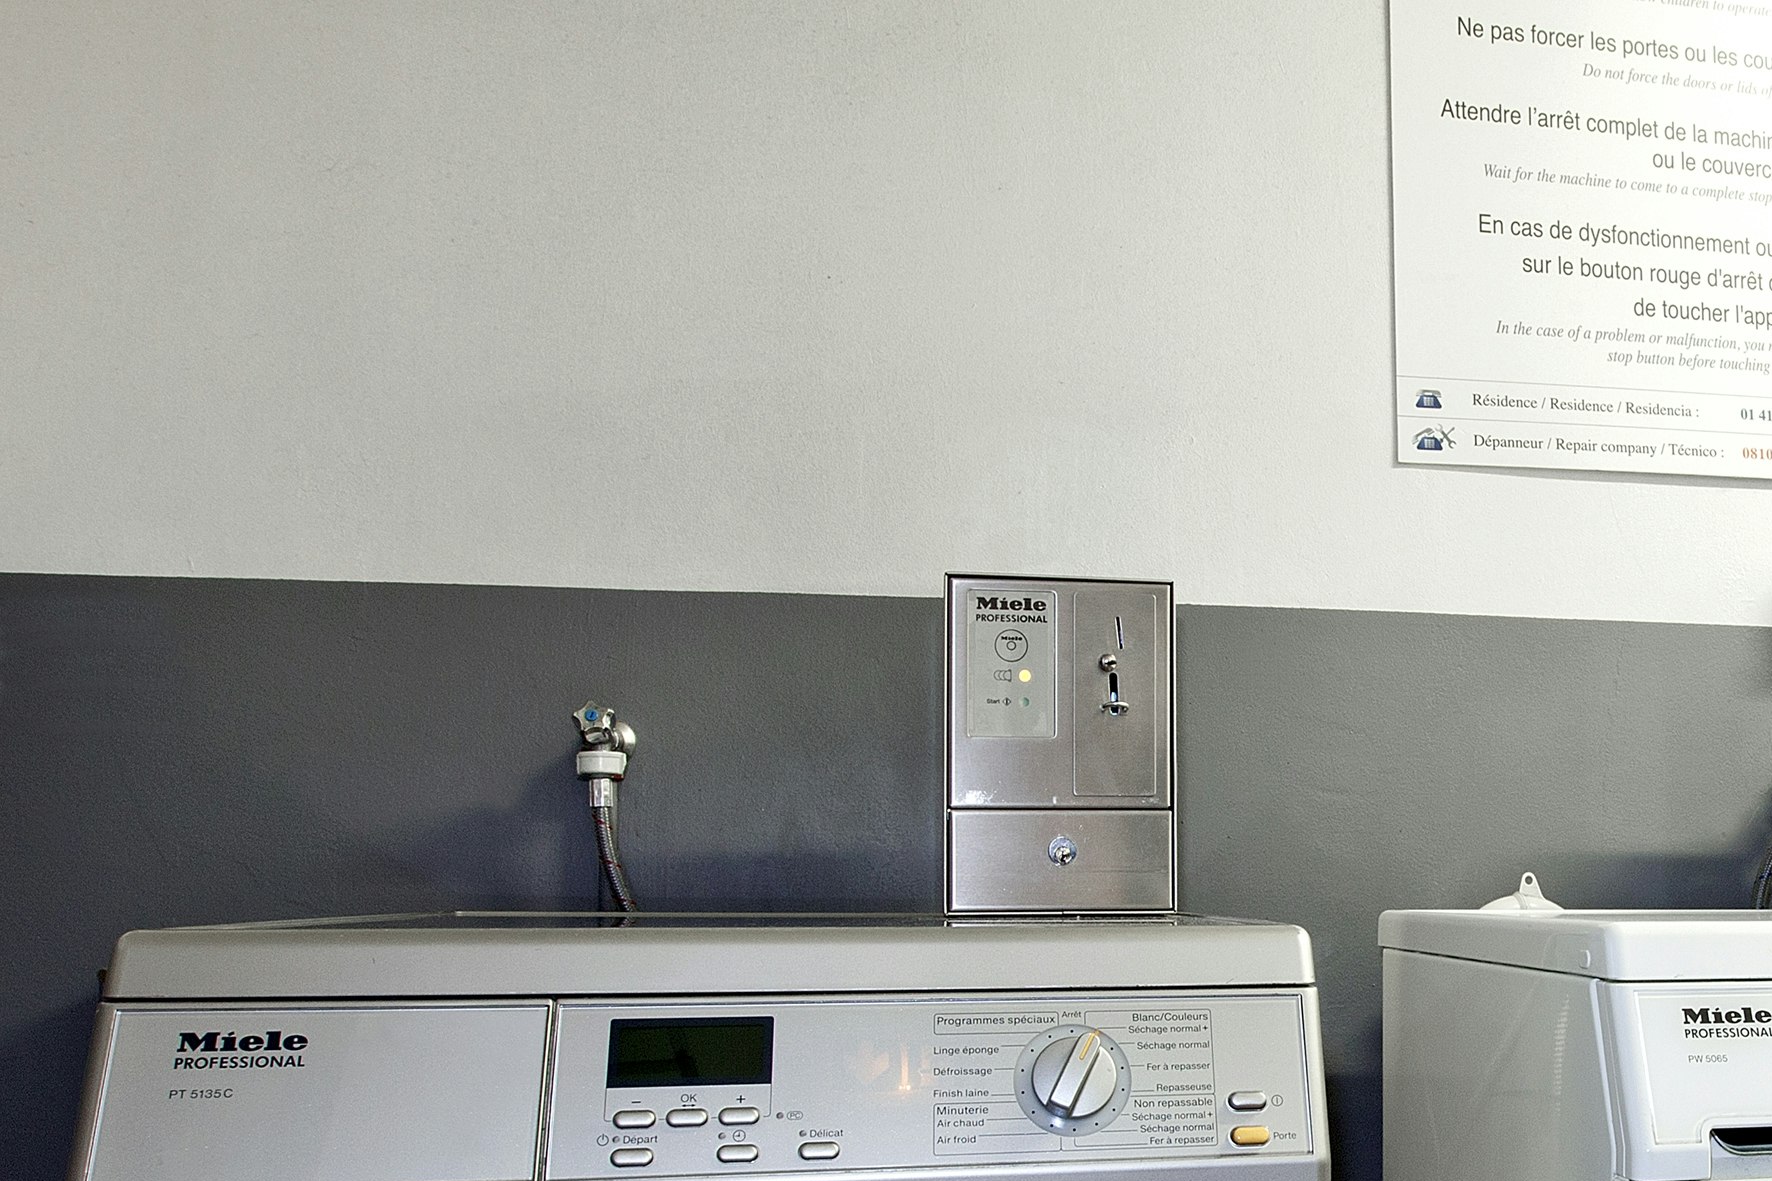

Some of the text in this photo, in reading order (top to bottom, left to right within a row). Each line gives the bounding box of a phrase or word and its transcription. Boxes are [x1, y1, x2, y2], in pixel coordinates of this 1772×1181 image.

[1457, 16, 1484, 38] Ne
[1491, 24, 1525, 44] pas
[1531, 25, 1584, 49] forcer
[1590, 31, 1616, 52] les
[1623, 38, 1679, 59] portes
[1685, 46, 1706, 63] ou
[1713, 46, 1738, 66] les
[1582, 63, 1717, 91] Do not force the doors
[1440, 98, 1521, 125] Attendre
[1586, 118, 1658, 140] complet
[1664, 121, 1686, 141] de
[1693, 124, 1708, 144] la
[1652, 153, 1674, 169] ou
[1681, 151, 1696, 171] le
[1484, 163, 1512, 179] Wait
[1512, 167, 1533, 183] for
[1537, 168, 1556, 183] the
[1559, 172, 1611, 189] machine
[1631, 180, 1662, 193] come
[1692, 185, 1745, 201] complete
[1748, 191, 1772, 206] stop
[1478, 213, 1504, 235] En
[1510, 219, 1543, 238] cas
[1549, 220, 1572, 240] de
[1579, 222, 1750, 255] dysfonctionnement
[1522, 257, 1552, 274] sur
[1557, 256, 1574, 276] le
[1580, 257, 1643, 281] bouton
[1650, 267, 1701, 290] rouge
[1707, 269, 1763, 291] d'arrêt
[1633, 298, 1730, 323] de toucher
[1496, 320, 1510, 335] In
[1513, 321, 1532, 336] the
[1536, 326, 1564, 338] case
[1567, 325, 1583, 342] of
[1594, 328, 1645, 344] problem
[1666, 333, 1741, 351] malfunction,
[1743, 340, 1765, 354] you
[1607, 351, 1633, 367] stop
[1636, 350, 1675, 367] button
[1678, 355, 1716, 371] before
[1719, 357, 1770, 375] touching
[1472, 394, 1614, 414] Résidence Residence
[1740, 407, 1755, 420] 01
[1759, 409, 1772, 422] 41
[1473, 434, 1717, 458] Dépanneur Repair company Técnico
[1742, 447, 1772, 461] 0810
[976, 597, 1047, 612] Miele
[976, 614, 1048, 623] PROFESSIONAL
[1061, 1010, 1082, 1019] Arrêt
[1132, 1012, 1208, 1022] Blanc/Couleurs
[1681, 1007, 1772, 1024] Miele
[936, 1015, 1056, 1027] Programmes spéciaux
[1128, 1025, 1168, 1035] Séchage
[176, 1030, 308, 1053] Miele
[1136, 1040, 1210, 1051] Séchage normal
[933, 1045, 999, 1056] Linge éponge
[173, 1055, 305, 1070] PROFESSIONAL
[1705, 1054, 1728, 1063] 5065
[933, 1066, 992, 1077] Défroissage
[1170, 1063, 1211, 1072] repasser
[933, 1088, 989, 1098] Finish laine
[1156, 1083, 1212, 1093] Repasseuse
[1134, 1098, 1213, 1109] Non repassable
[936, 1105, 989, 1116] Minuterie
[953, 1118, 985, 1127] chaud
[1131, 1112, 1172, 1122] Séchage
[809, 1128, 844, 1138] Délicat
[1140, 1123, 1214, 1134] Séchage normal
[623, 1134, 659, 1147] Départ
[953, 1135, 977, 1144] froid
[1174, 1135, 1214, 1146] repasser
[1273, 1131, 1297, 1140] Porte
